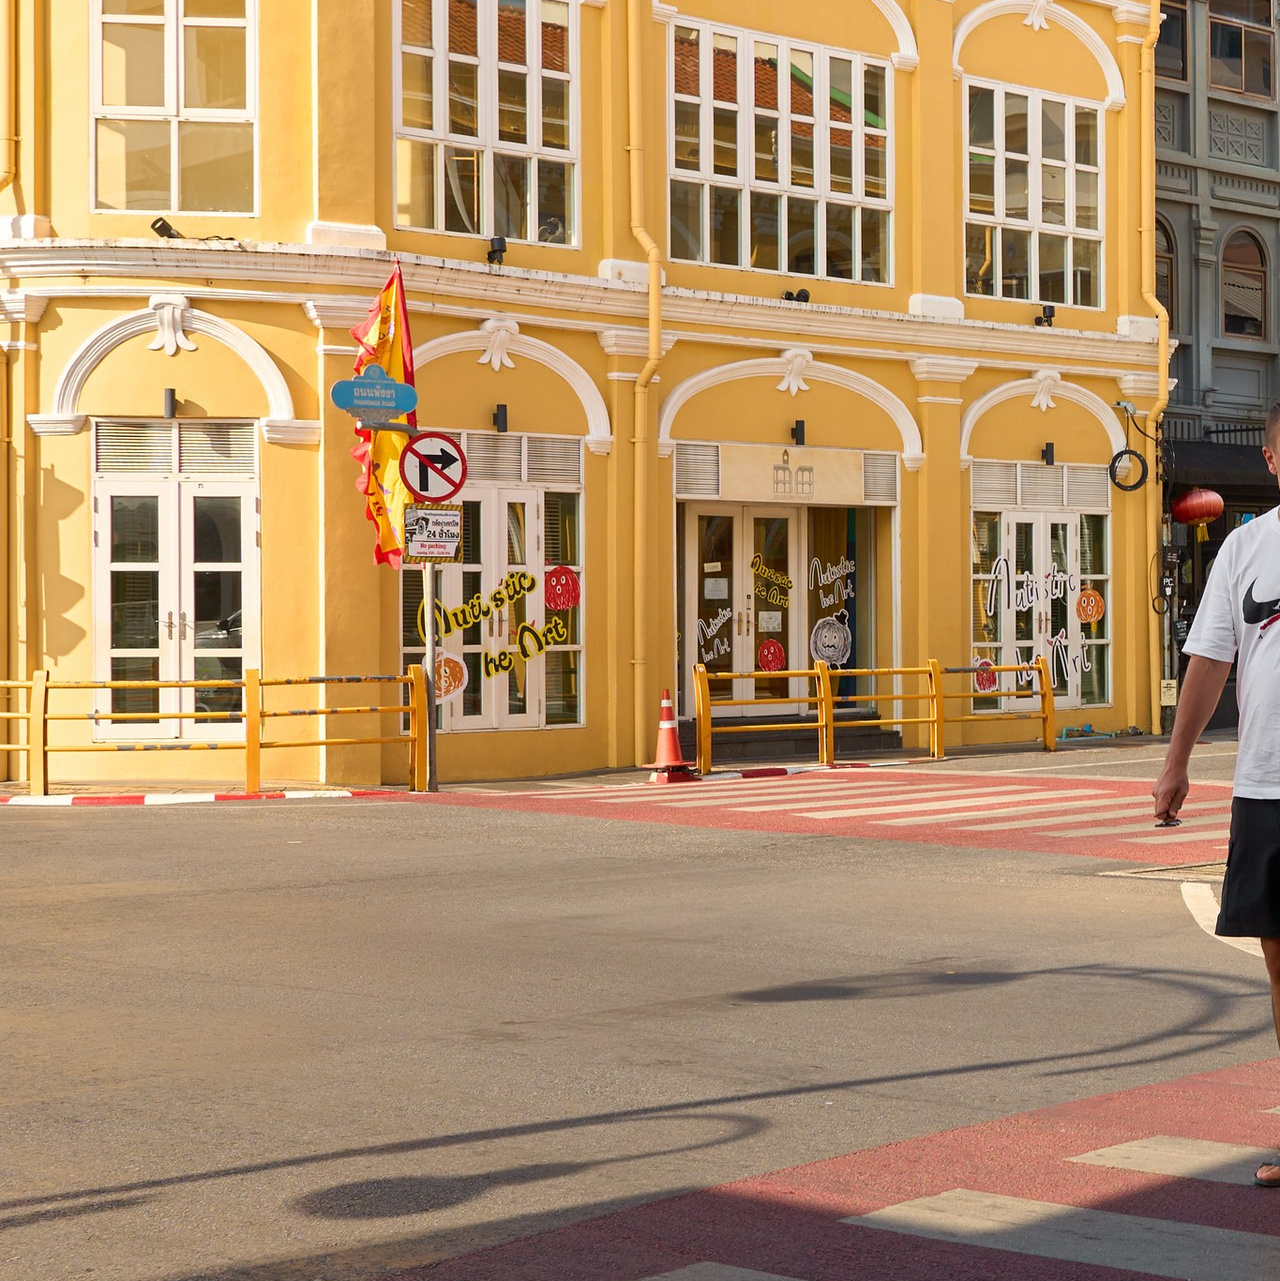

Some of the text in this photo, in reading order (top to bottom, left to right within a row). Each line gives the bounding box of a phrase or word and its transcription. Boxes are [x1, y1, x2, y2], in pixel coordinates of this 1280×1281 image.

[353, 385, 396, 399] ถนนพังงา
[427, 526, 460, 539] 24 ชั่วโมง
[767, 585, 790, 608] Art
[834, 579, 855, 604] Art
[517, 616, 568, 661] Art
[714, 637, 731, 659] Art
[1051, 632, 1092, 688] Art
